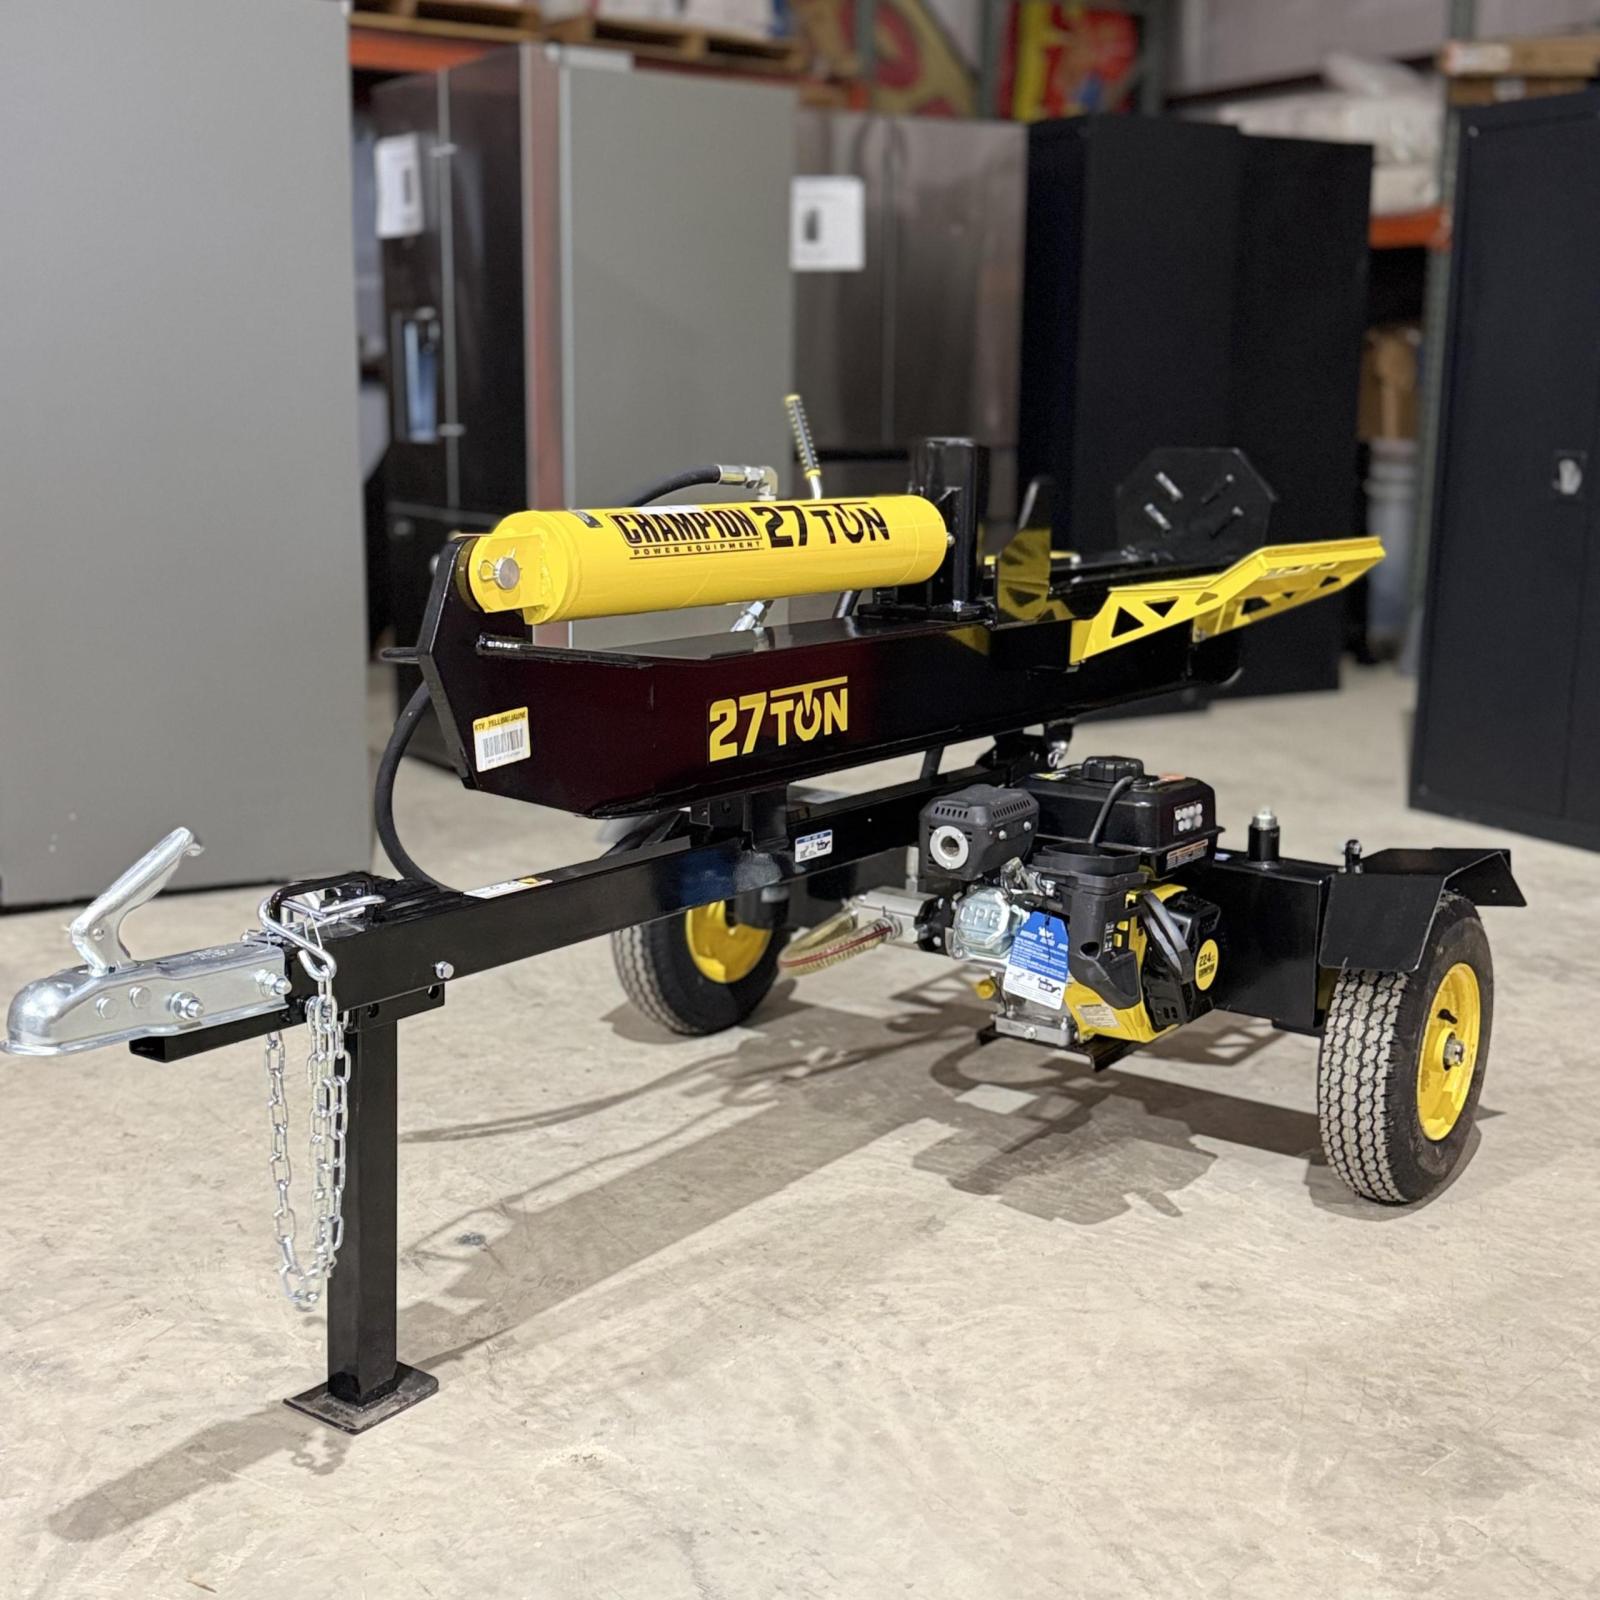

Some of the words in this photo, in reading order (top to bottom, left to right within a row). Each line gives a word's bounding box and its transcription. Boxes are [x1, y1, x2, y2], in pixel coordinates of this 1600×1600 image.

[610, 509, 759, 544] CHAMPION
[750, 505, 808, 548] 27
[801, 502, 890, 544] TON
[634, 547, 680, 556] POWER
[687, 541, 761, 553] EQUIPMENT
[709, 691, 767, 763] 27
[770, 676, 848, 746] TON
